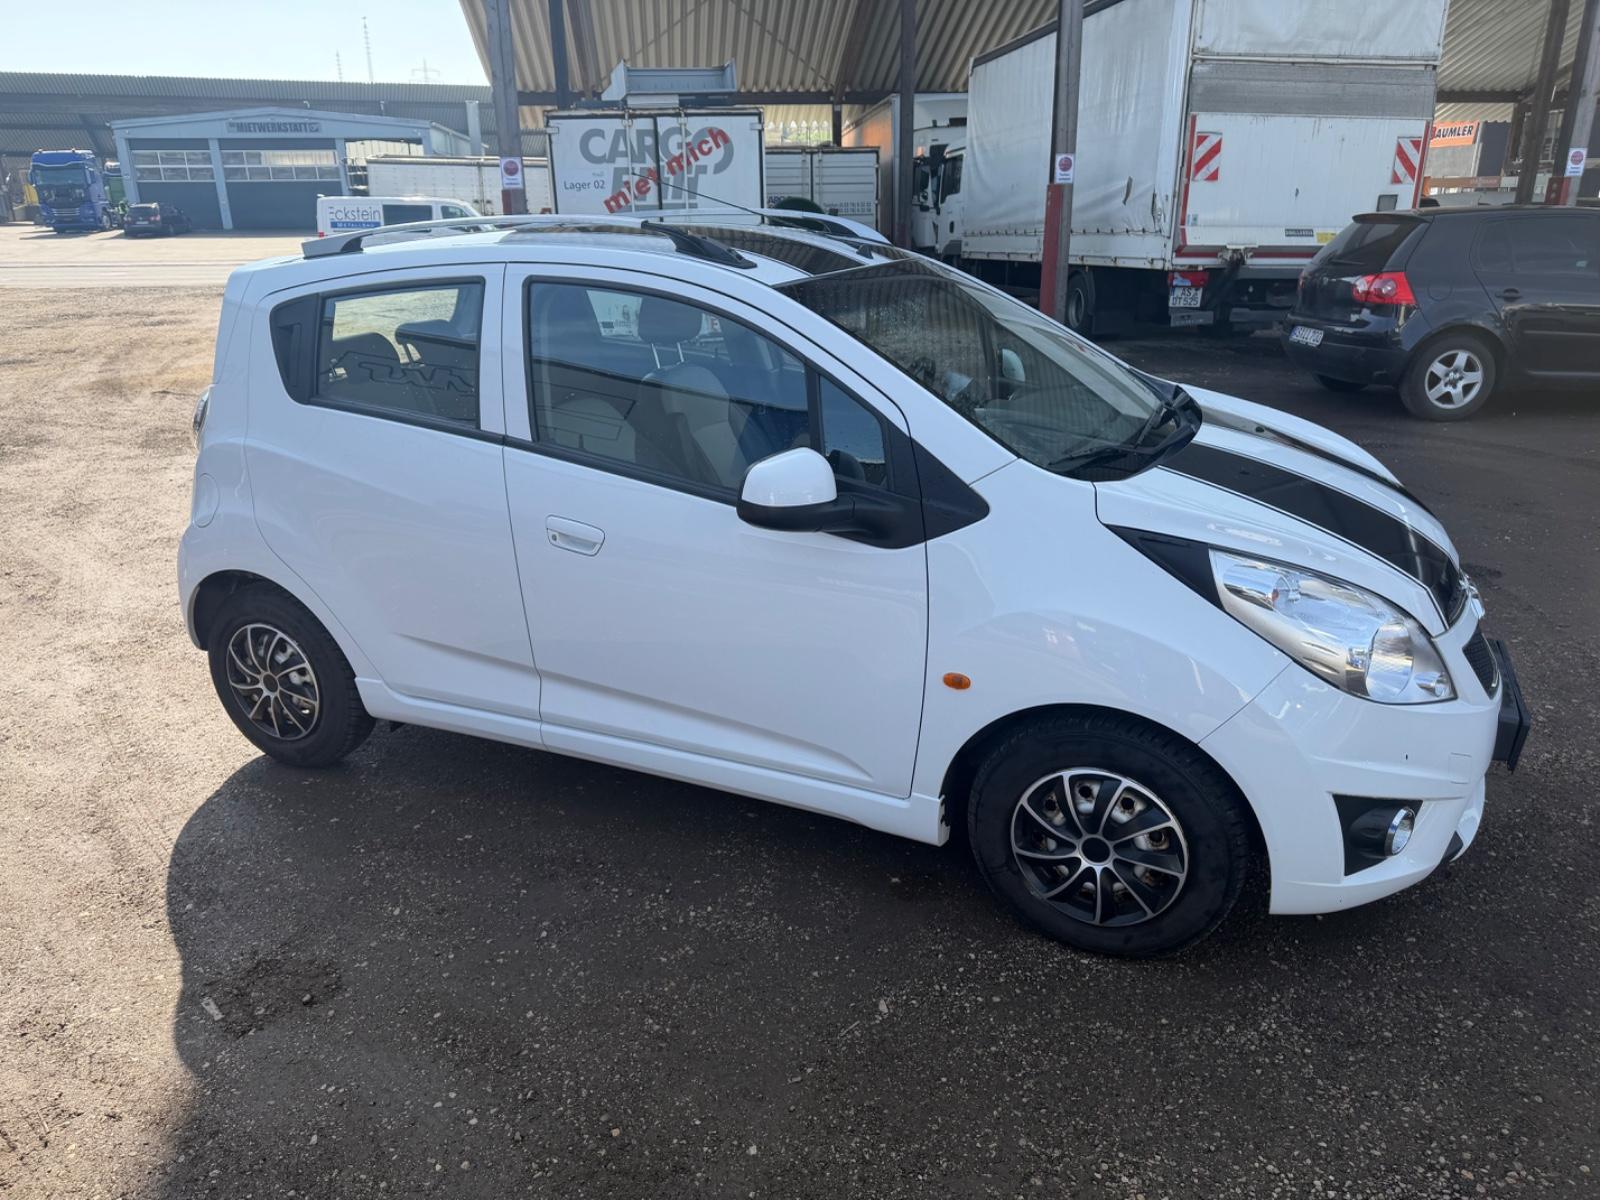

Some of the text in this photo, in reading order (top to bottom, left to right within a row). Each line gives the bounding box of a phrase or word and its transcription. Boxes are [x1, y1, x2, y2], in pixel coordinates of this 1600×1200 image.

[665, 128, 730, 176] mich
[564, 180, 606, 192] Lager 02
[328, 206, 382, 221] Eckstein
